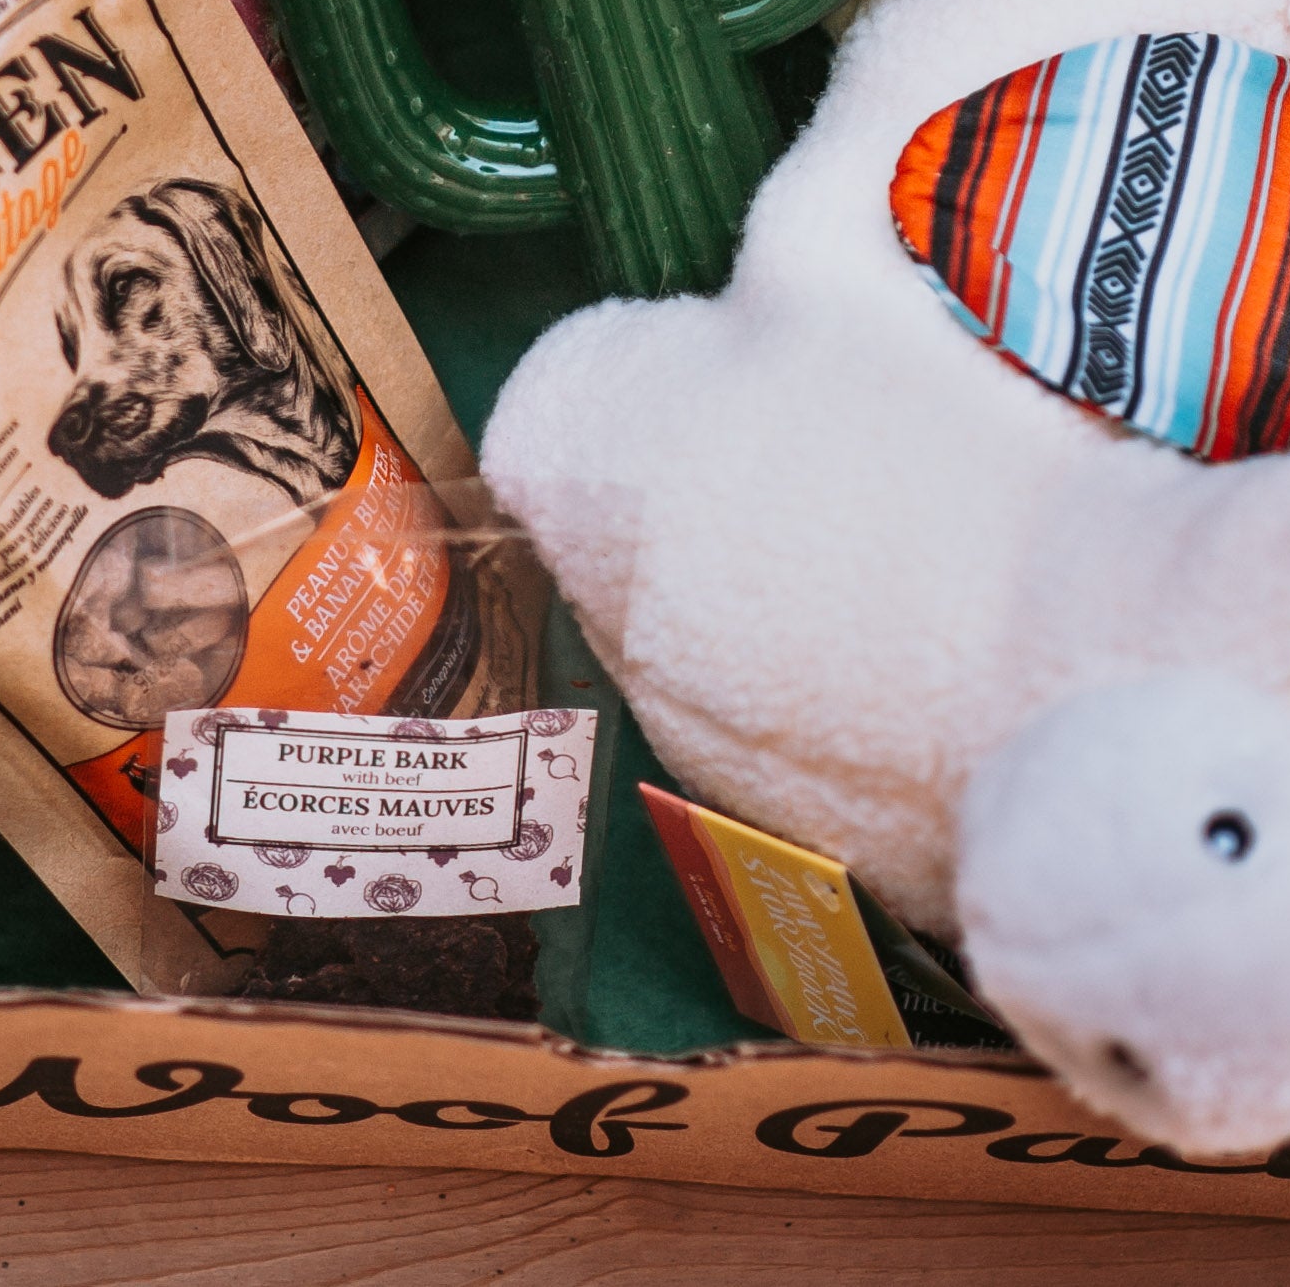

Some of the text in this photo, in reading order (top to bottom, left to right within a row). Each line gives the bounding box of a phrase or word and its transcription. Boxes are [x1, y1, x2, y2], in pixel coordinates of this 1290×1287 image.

[23, 495, 55, 536] perros
[25, 502, 71, 554] delicioso
[33, 502, 90, 573] mantequilla
[282, 443, 391, 624] PEANUT BUTTER
[287, 637, 315, 665] &
[301, 538, 383, 643] BANANA
[317, 594, 394, 689] ARÔME
[382, 560, 419, 601] DE
[329, 590, 430, 721] 'ARACHIDE
[408, 561, 445, 598] ET
[278, 743, 468, 770] PURPLE BARK
[342, 771, 424, 787] with beef
[242, 786, 496, 818] ÉCORCES MAUVES
[331, 822, 425, 837] avec boeuf
